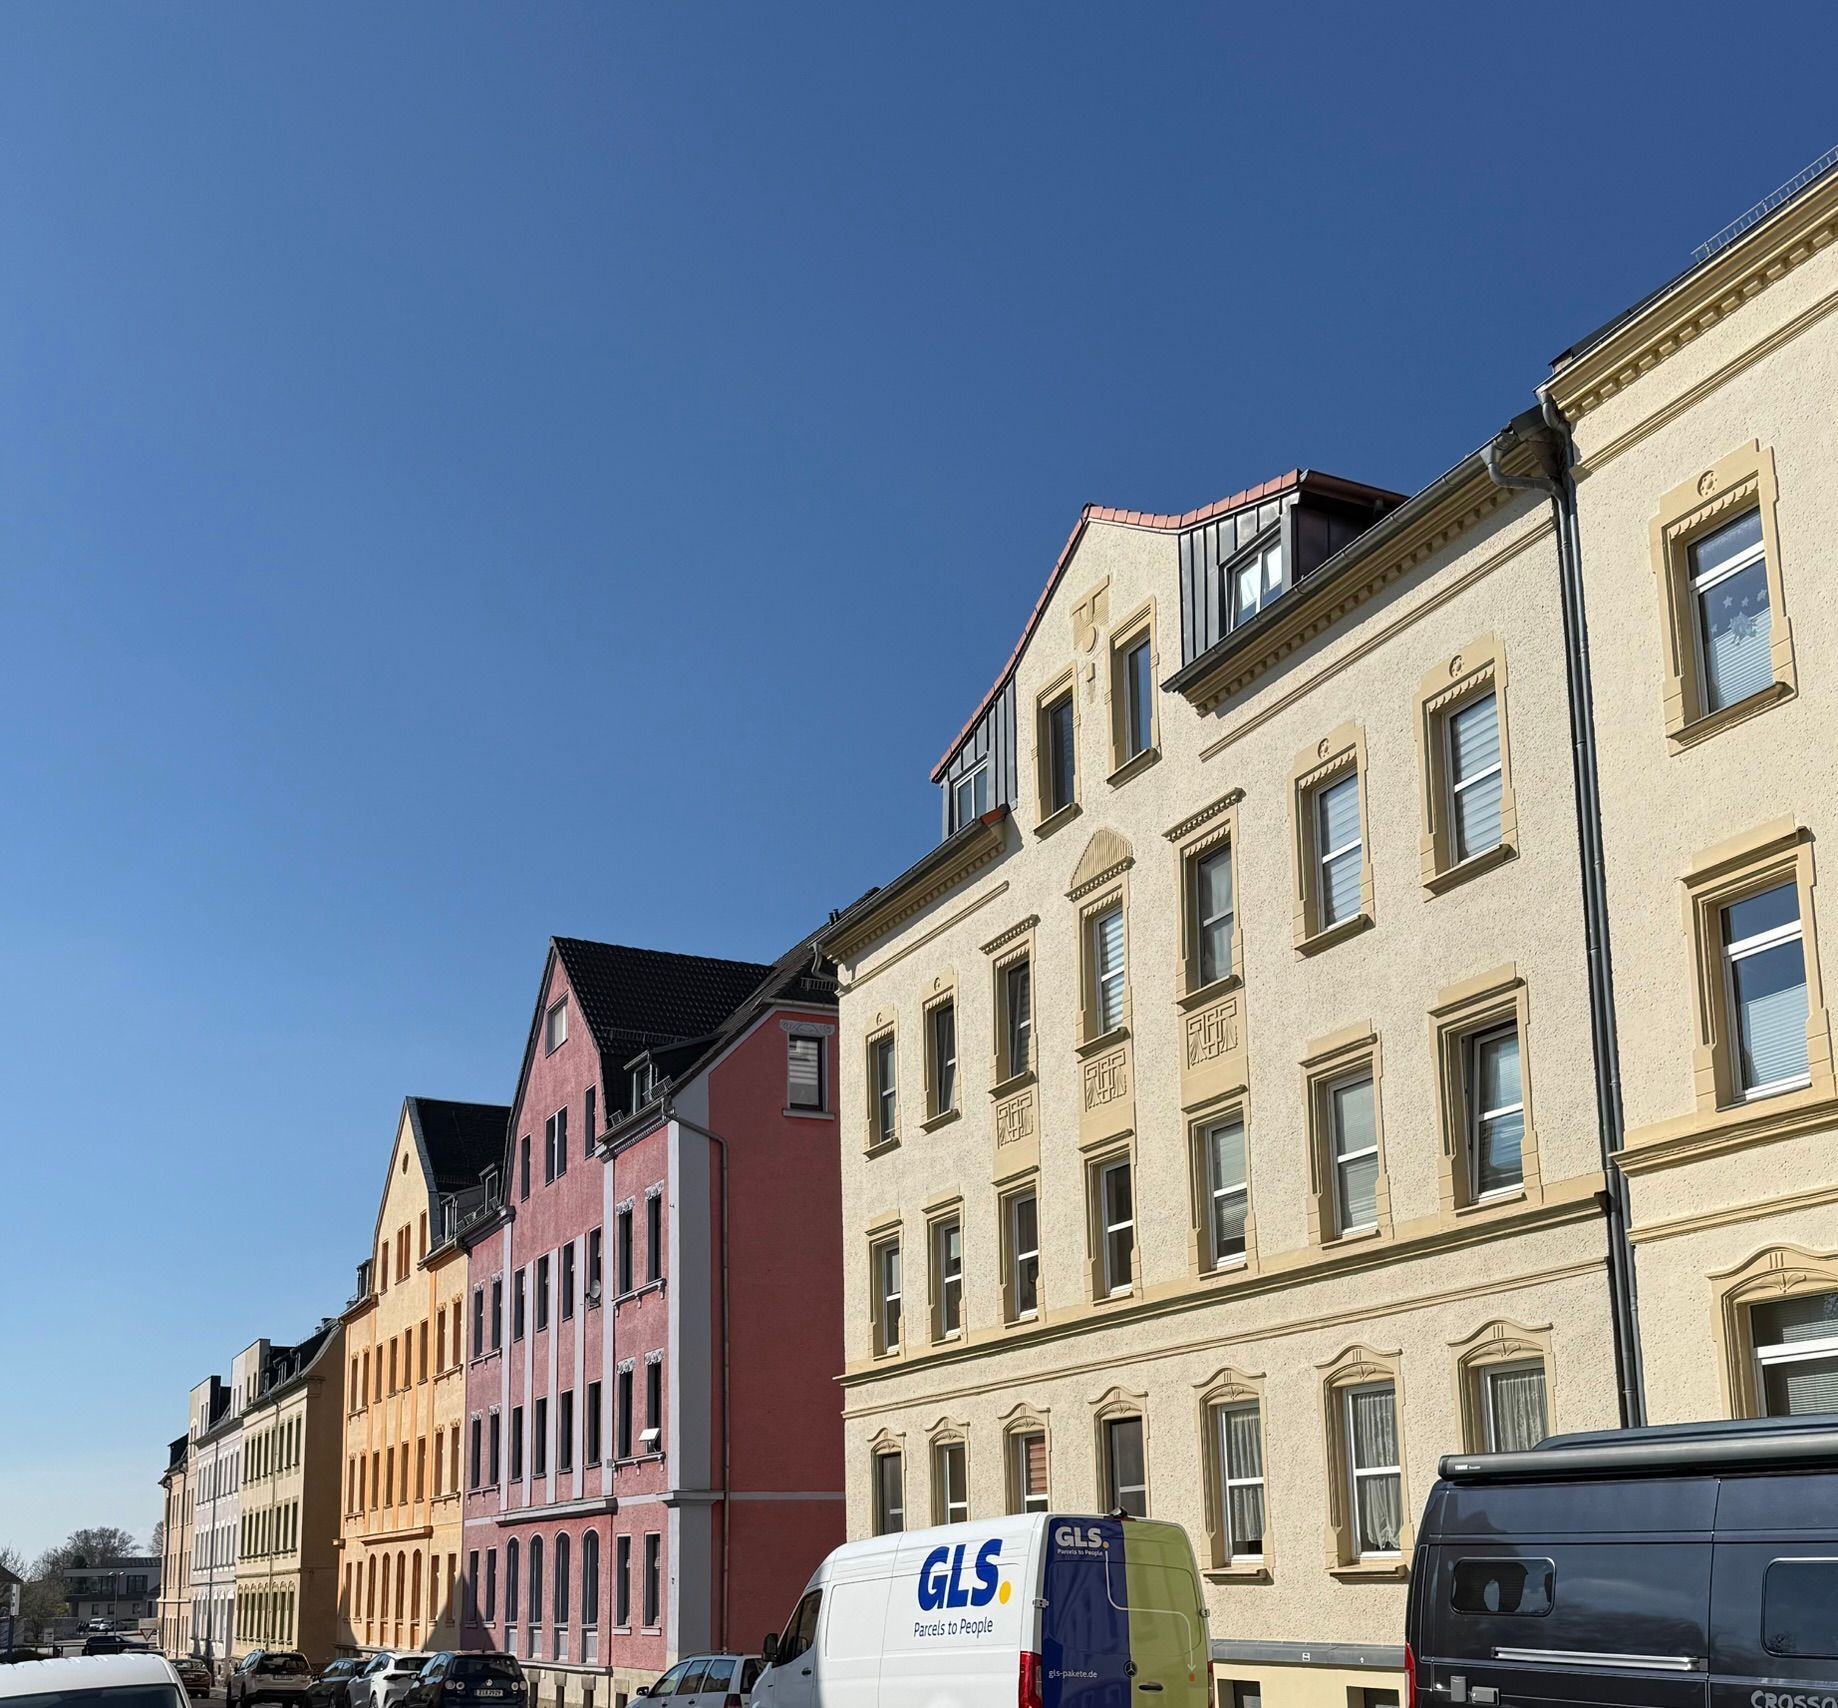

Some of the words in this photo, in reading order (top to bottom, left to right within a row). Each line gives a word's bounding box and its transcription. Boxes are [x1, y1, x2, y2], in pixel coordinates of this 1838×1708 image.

[1085, 1549, 1103, 1557] People
[914, 1620, 945, 1637] Parcels
[948, 1621, 957, 1635] to
[960, 1617, 993, 1638] People
[1048, 1669, 1098, 1679] gls-pakete.de
